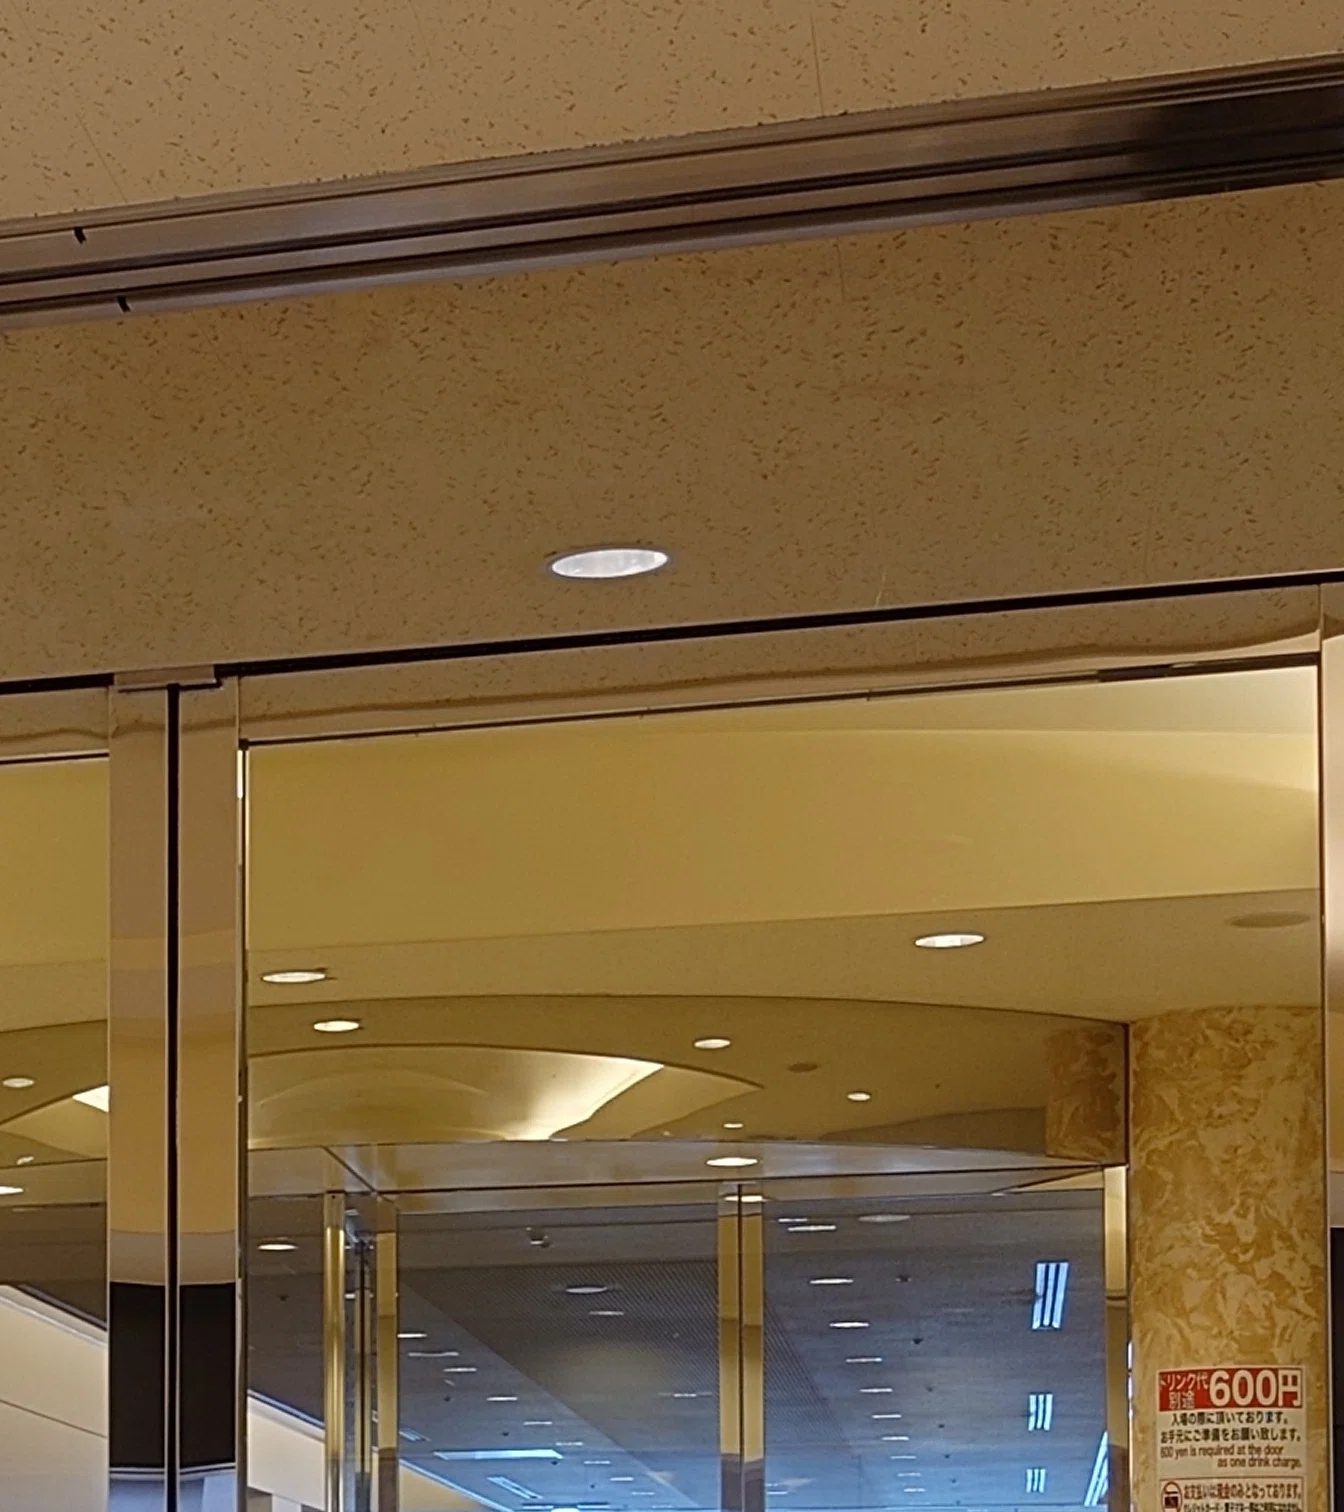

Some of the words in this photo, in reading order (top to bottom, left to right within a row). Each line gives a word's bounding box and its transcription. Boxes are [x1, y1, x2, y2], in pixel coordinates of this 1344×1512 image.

[1209, 1369, 1302, 1407] 600円
[1175, 1448, 1189, 1460] yen
[1198, 1445, 1234, 1458] required
[1237, 1445, 1246, 1455] at
[1248, 1444, 1262, 1455] the
[1265, 1444, 1284, 1455] door
[1217, 1459, 1229, 1468] as
[1230, 1458, 1246, 1467] one
[1248, 1457, 1270, 1467] drink
